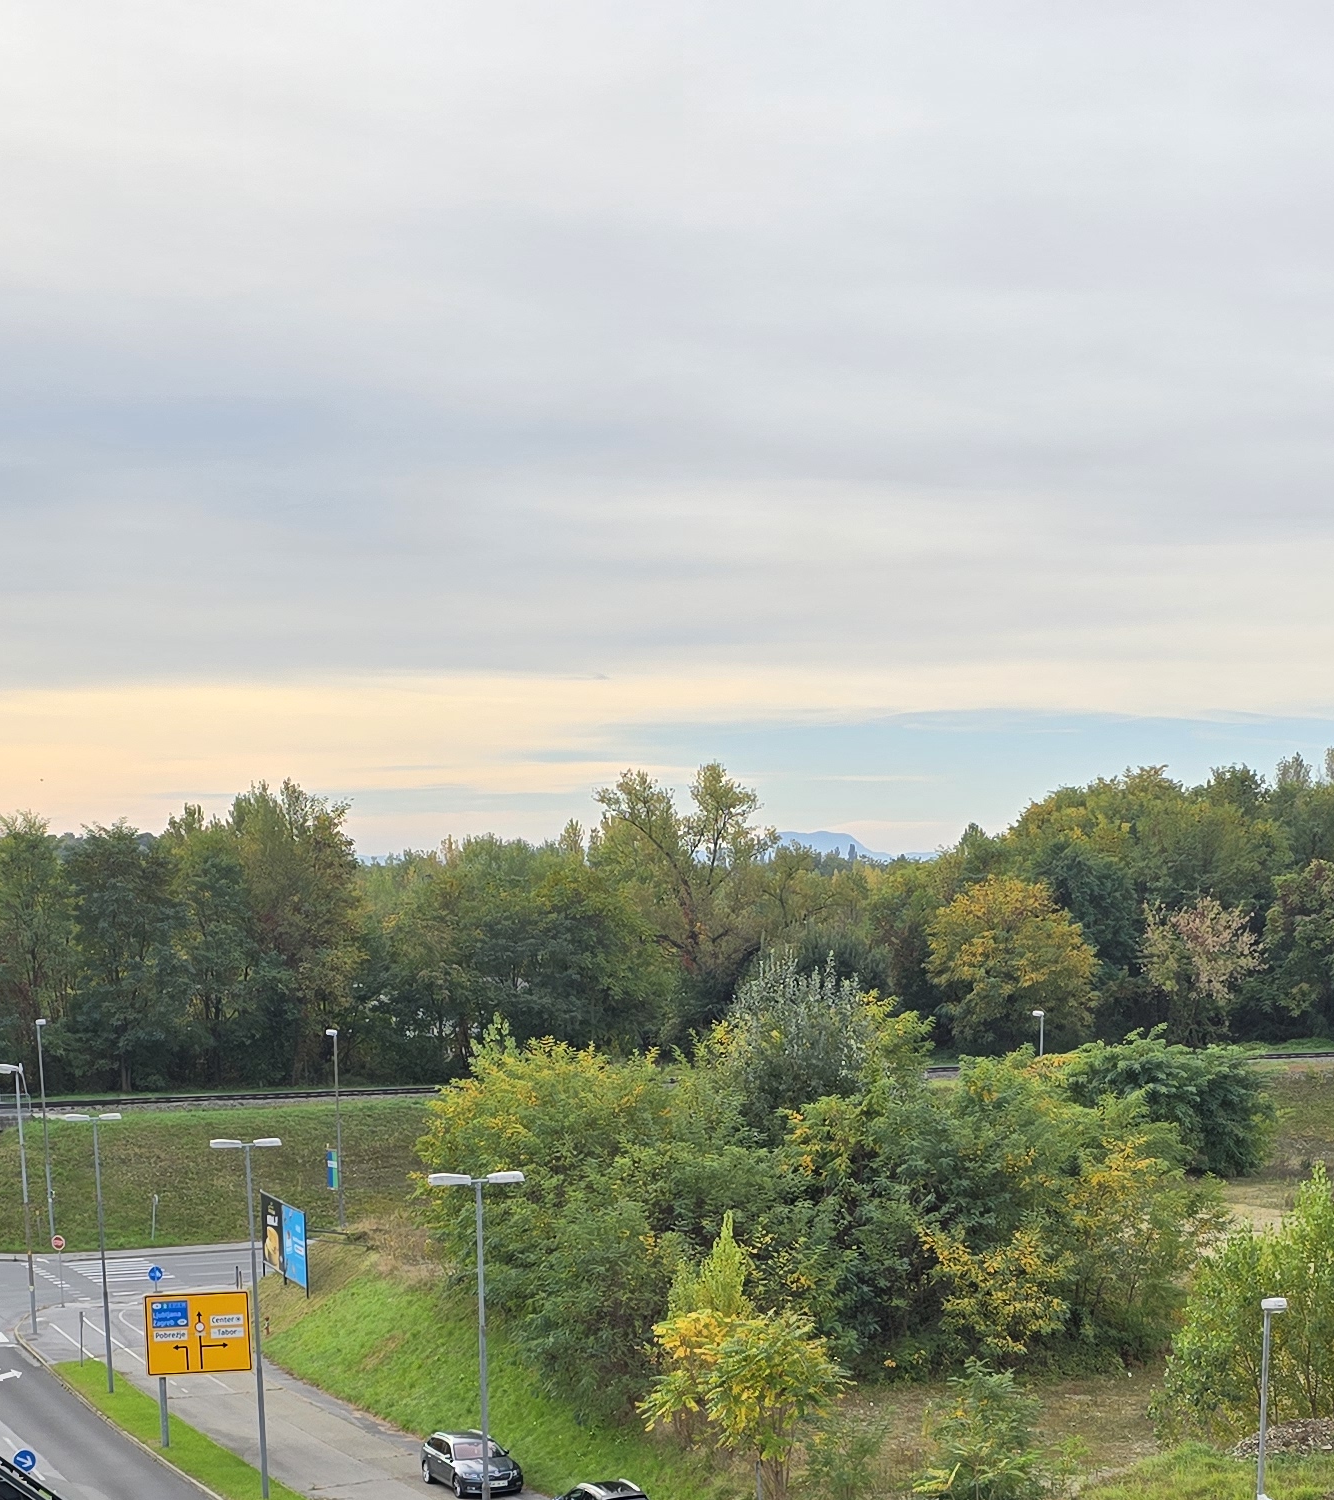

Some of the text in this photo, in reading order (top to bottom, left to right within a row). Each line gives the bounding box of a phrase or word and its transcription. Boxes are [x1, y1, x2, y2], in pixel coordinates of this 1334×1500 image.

[152, 1311, 182, 1320] Ljubljana
[211, 1315, 234, 1324] Center
[155, 1331, 186, 1340] Pobrežje
[217, 1328, 237, 1336] Tabor
